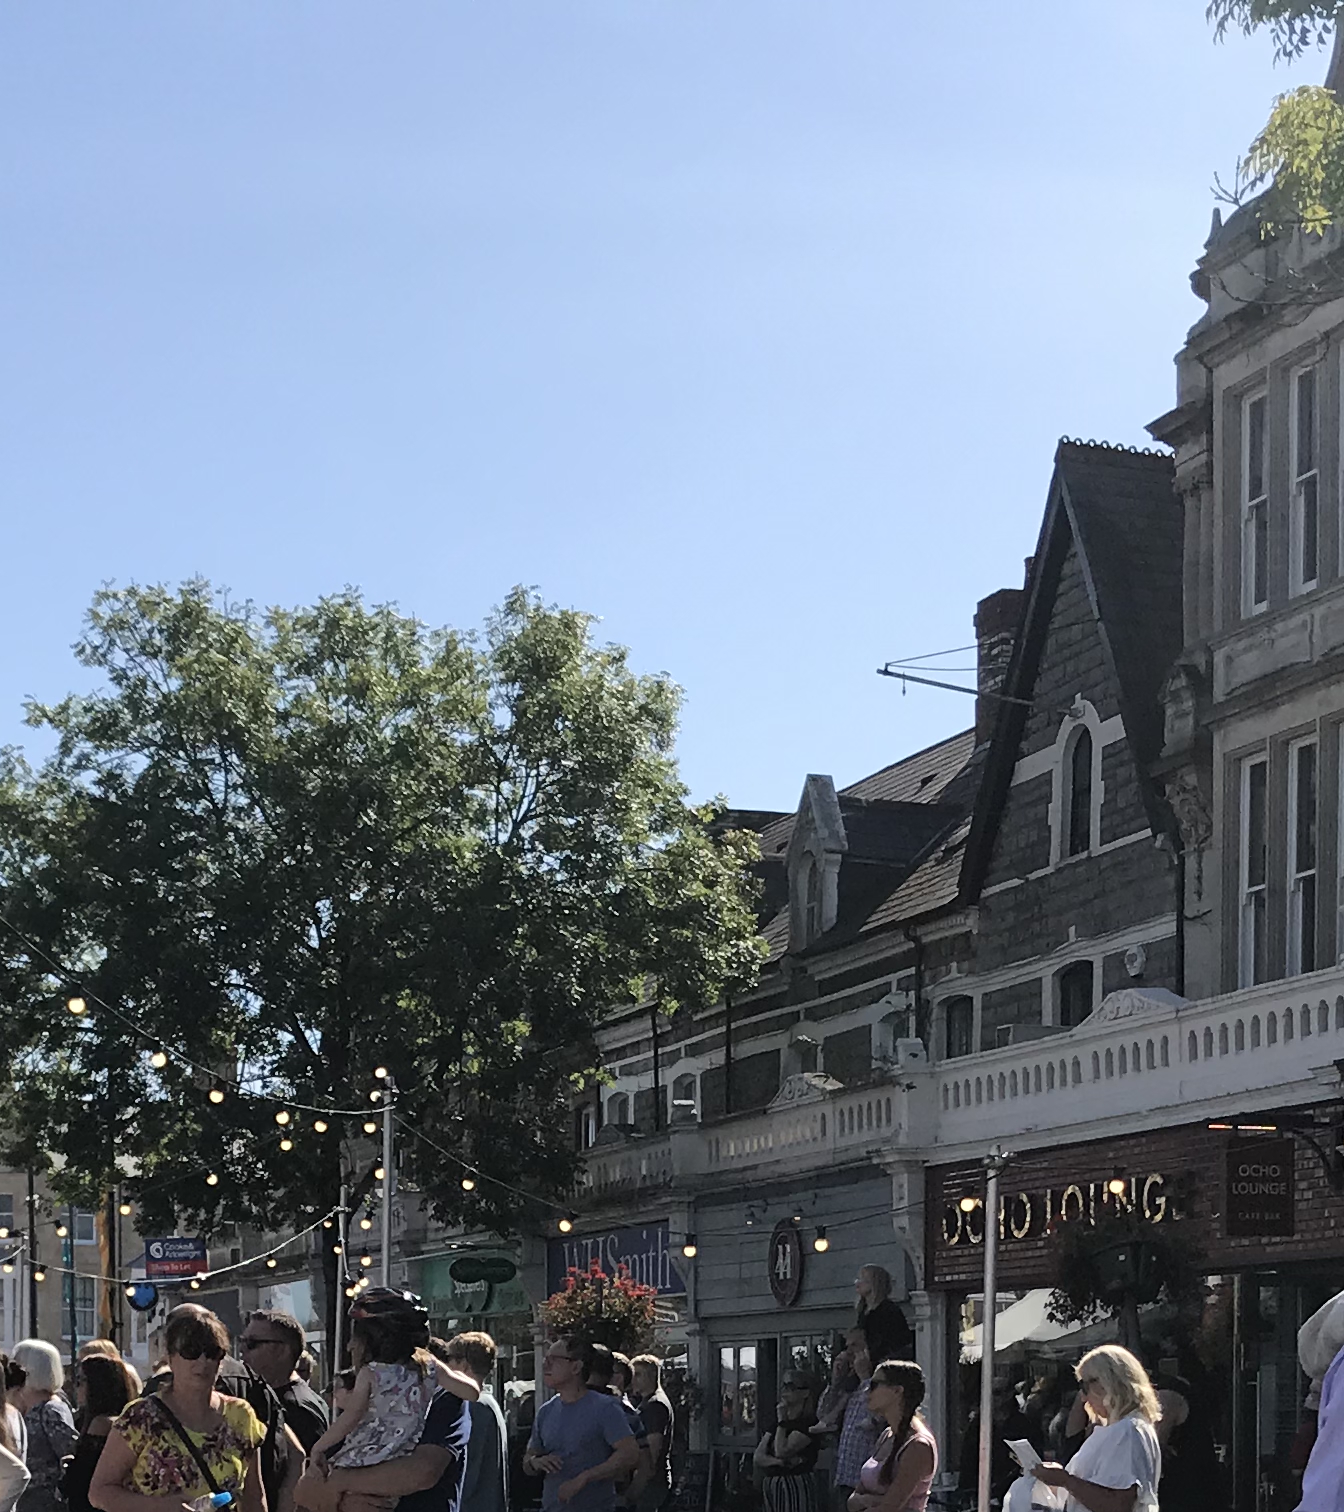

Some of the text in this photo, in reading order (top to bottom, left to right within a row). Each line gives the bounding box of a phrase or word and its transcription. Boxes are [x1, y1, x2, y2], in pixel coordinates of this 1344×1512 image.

[1237, 1164, 1280, 1177] OCHO
[1232, 1182, 1287, 1195] LOUNGE
[1041, 1173, 1185, 1238] LOUNG
